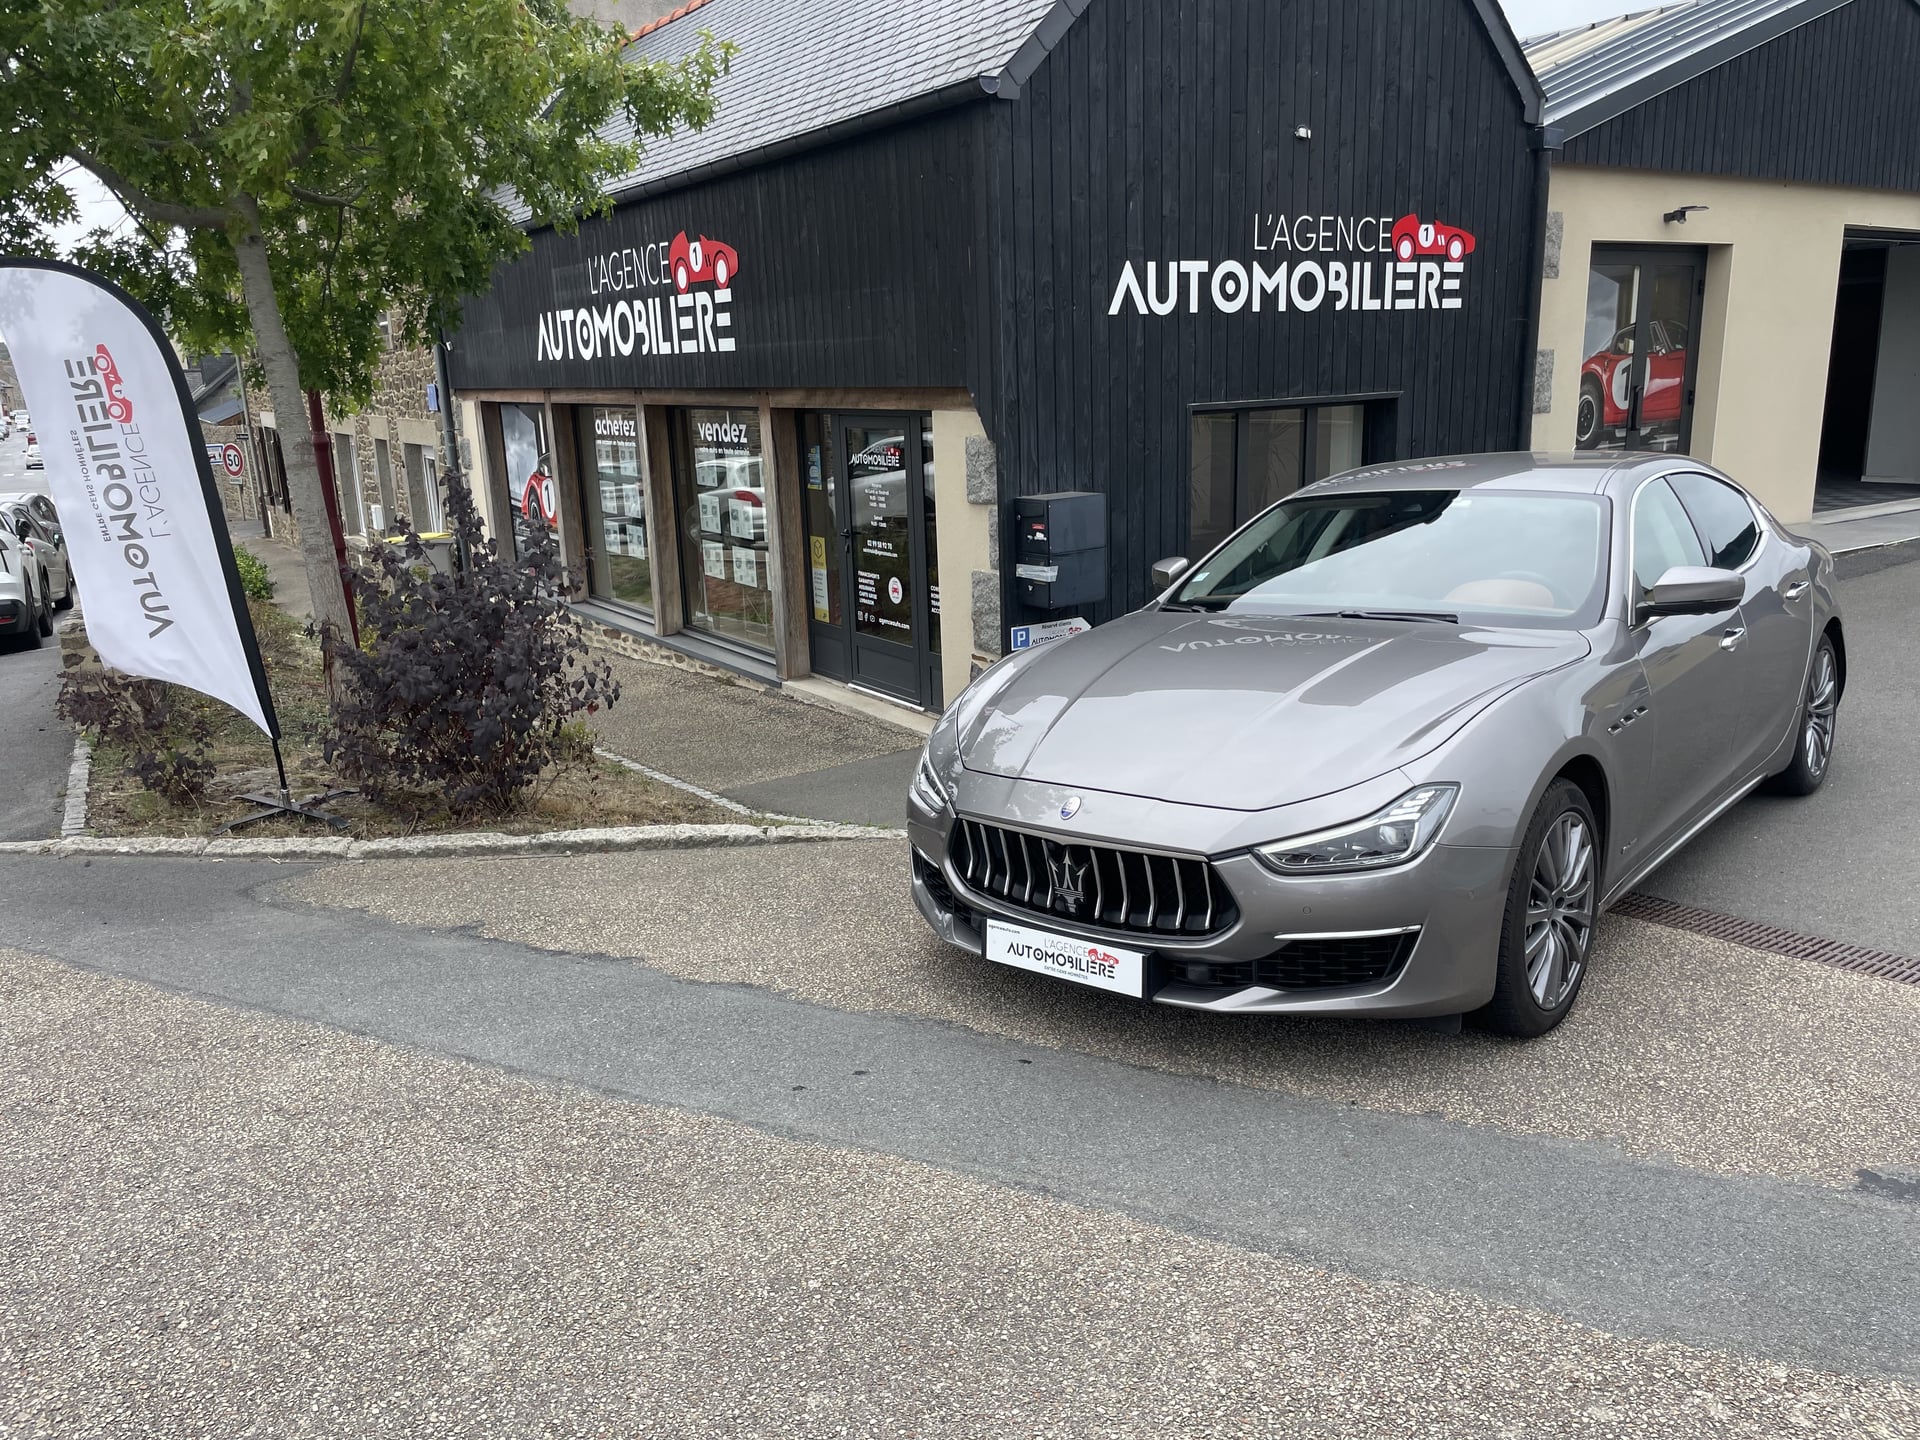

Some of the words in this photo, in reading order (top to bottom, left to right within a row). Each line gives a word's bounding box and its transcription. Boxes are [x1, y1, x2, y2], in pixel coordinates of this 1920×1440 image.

[1253, 213, 1393, 253] L'AGENCE
[587, 241, 672, 295] L'AGENCE
[595, 409, 636, 437] achetez
[697, 410, 748, 443] vendez
[227, 453, 240, 467] 50
[1017, 630, 1026, 646] P
[1044, 937, 1089, 957] L'AGENCE
